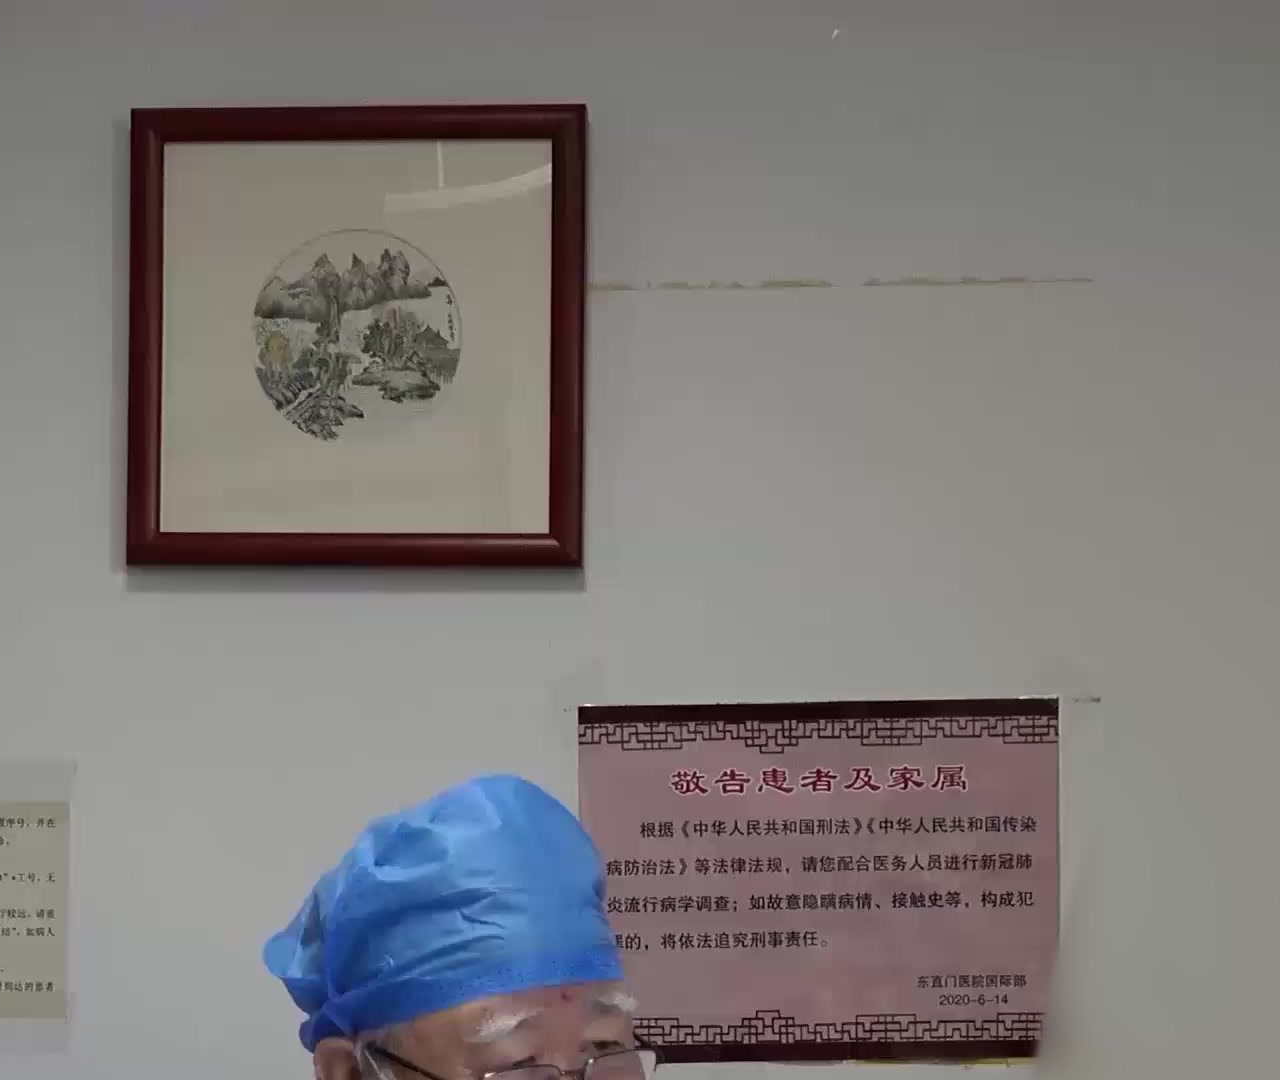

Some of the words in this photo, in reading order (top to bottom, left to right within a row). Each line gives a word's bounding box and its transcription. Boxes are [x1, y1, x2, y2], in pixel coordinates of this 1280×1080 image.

[670, 765, 969, 795] 敬告患者及家属
[639, 815, 1038, 839] 根据《中华人民共和国刑法》《中华人民共和国传染
[606, 852, 1033, 877] 病防治法》等法律法规，请您配合医务人员进行新冠肺
[606, 889, 1035, 914] 炎流行病学调查；如故意隐瞒病情、接触史等，构成犯
[917, 974, 1028, 989] 东直门医院国际部
[939, 993, 1009, 1006] 2020-6-14
